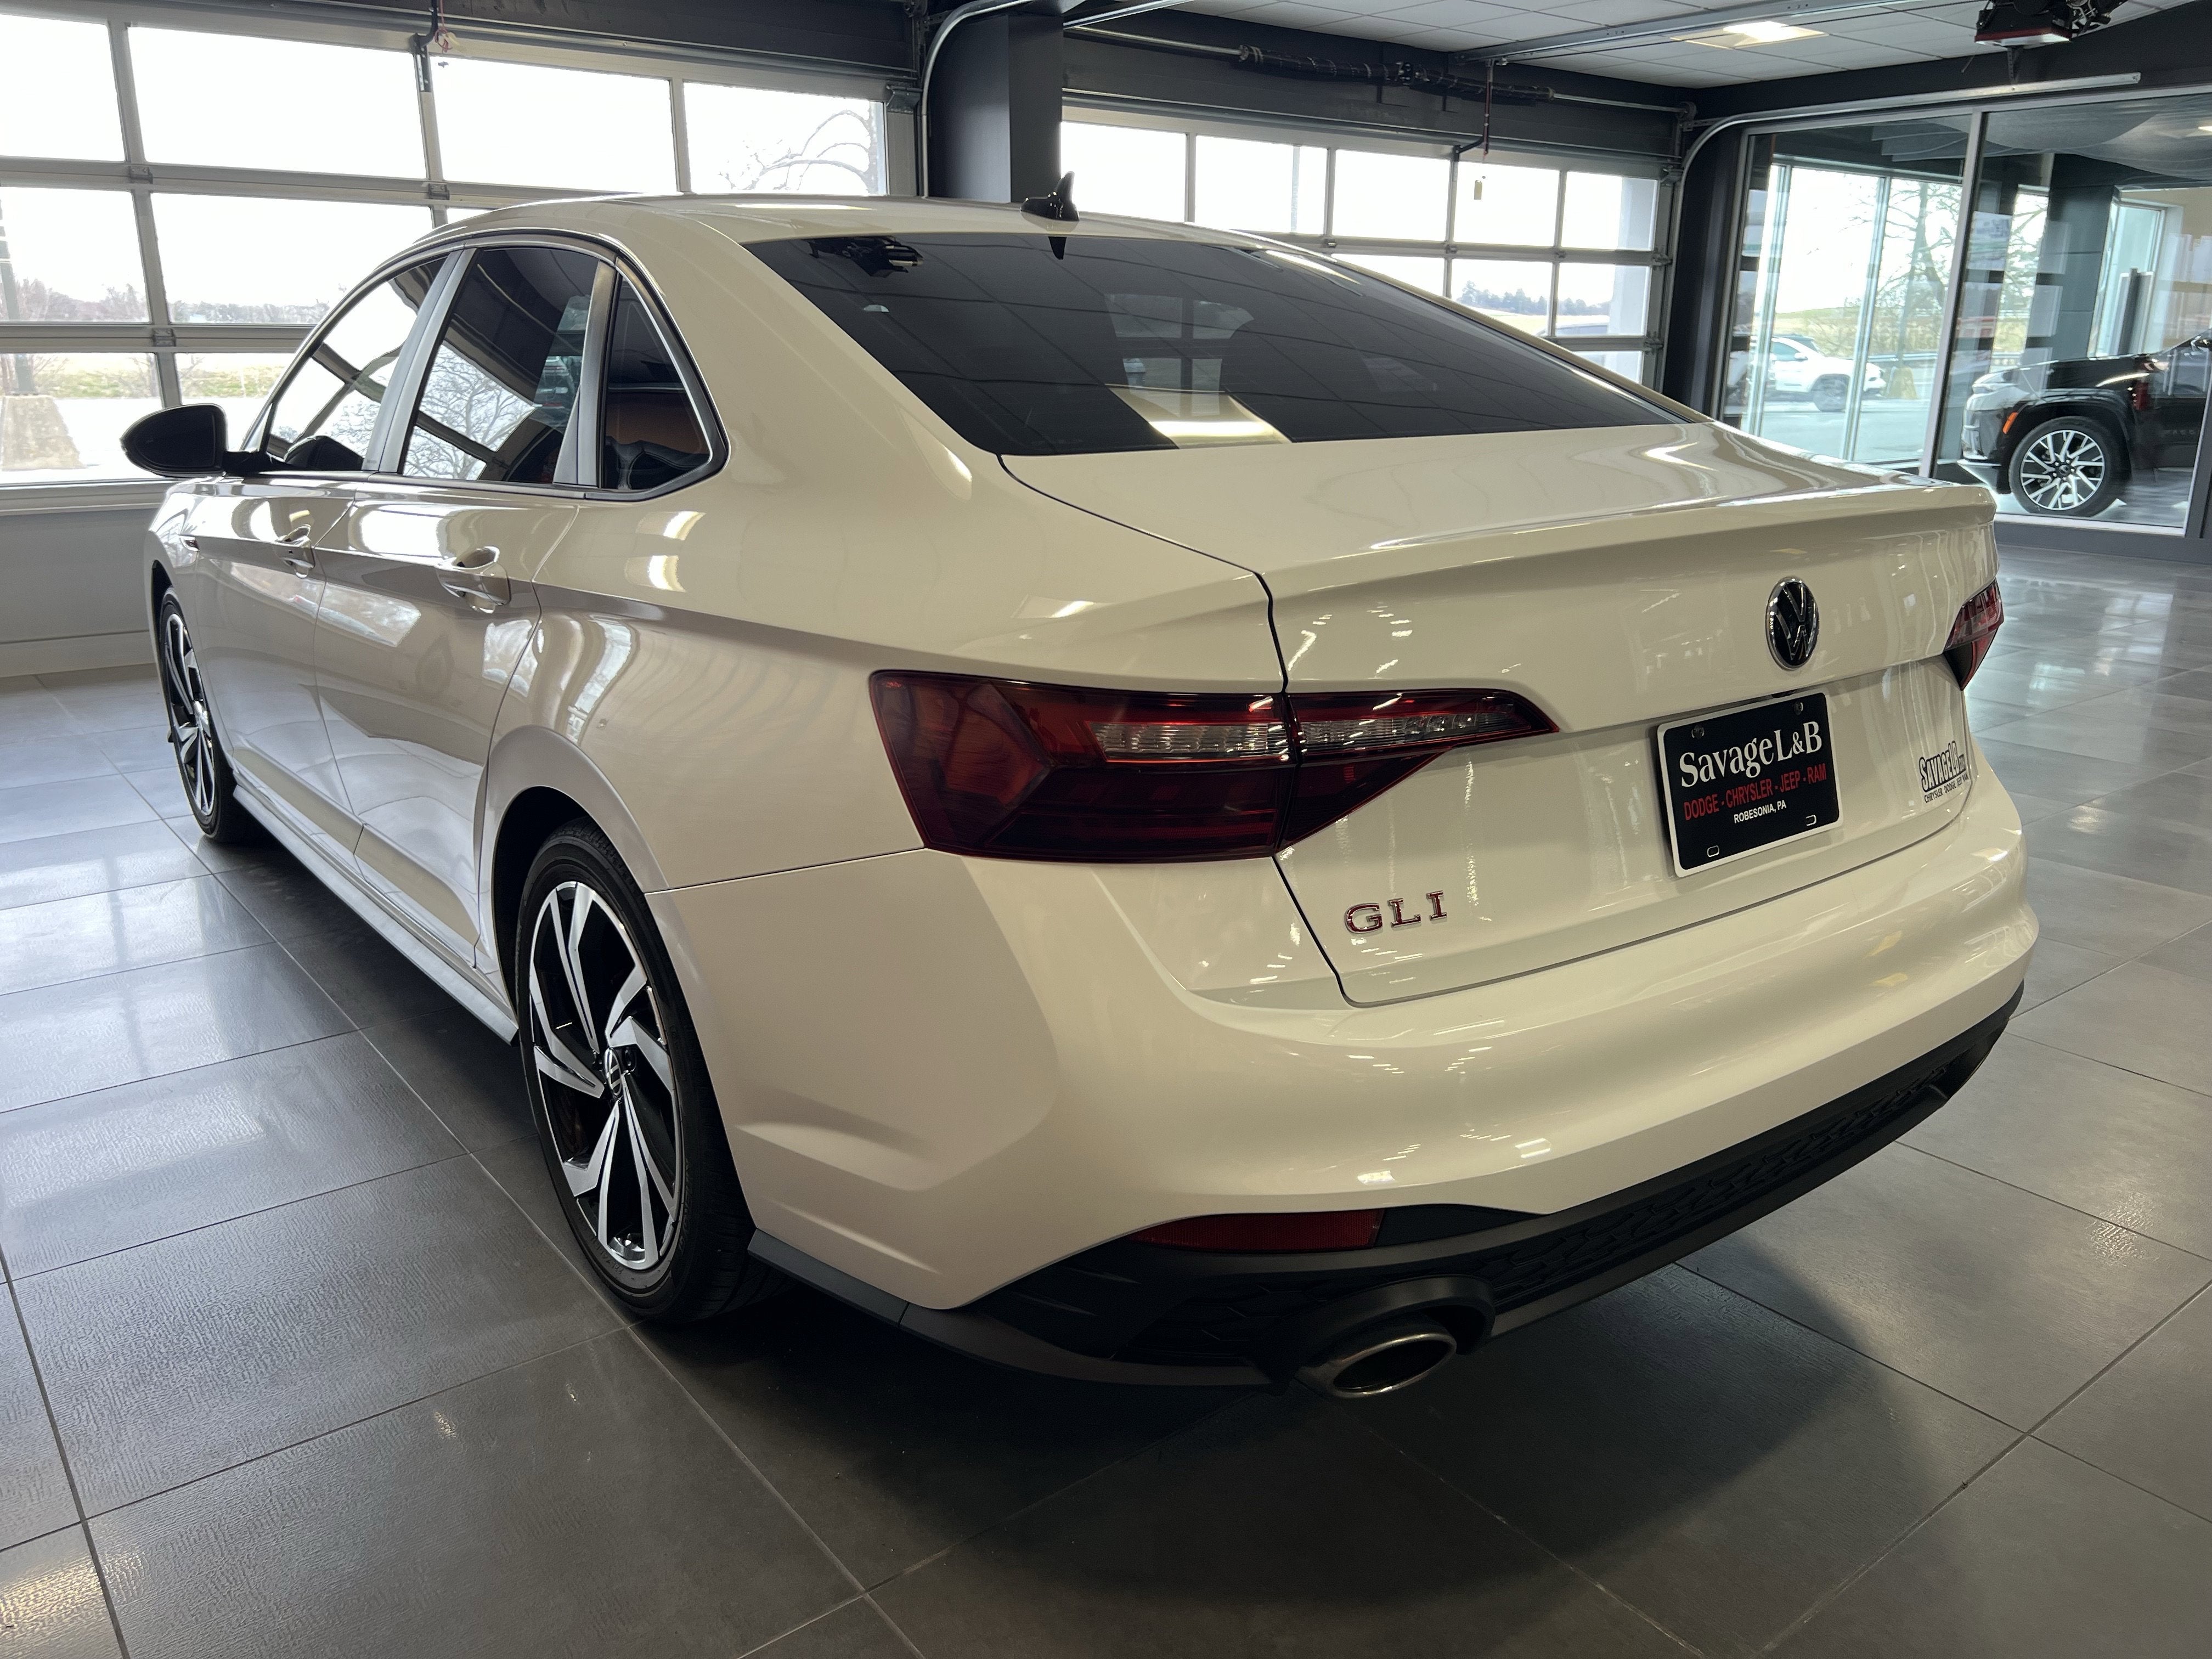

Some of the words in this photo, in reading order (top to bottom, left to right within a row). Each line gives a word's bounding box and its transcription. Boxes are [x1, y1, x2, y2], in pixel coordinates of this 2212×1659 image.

[1684, 793, 1719, 821] DODGE
[1725, 778, 1774, 808] CHRYSLER
[1780, 770, 1800, 793] JEEP
[1807, 763, 1826, 784] RAM
[1734, 803, 1776, 823] ROBESONIA,
[1777, 800, 1787, 811] PA
[1345, 890, 1447, 934] GLI
